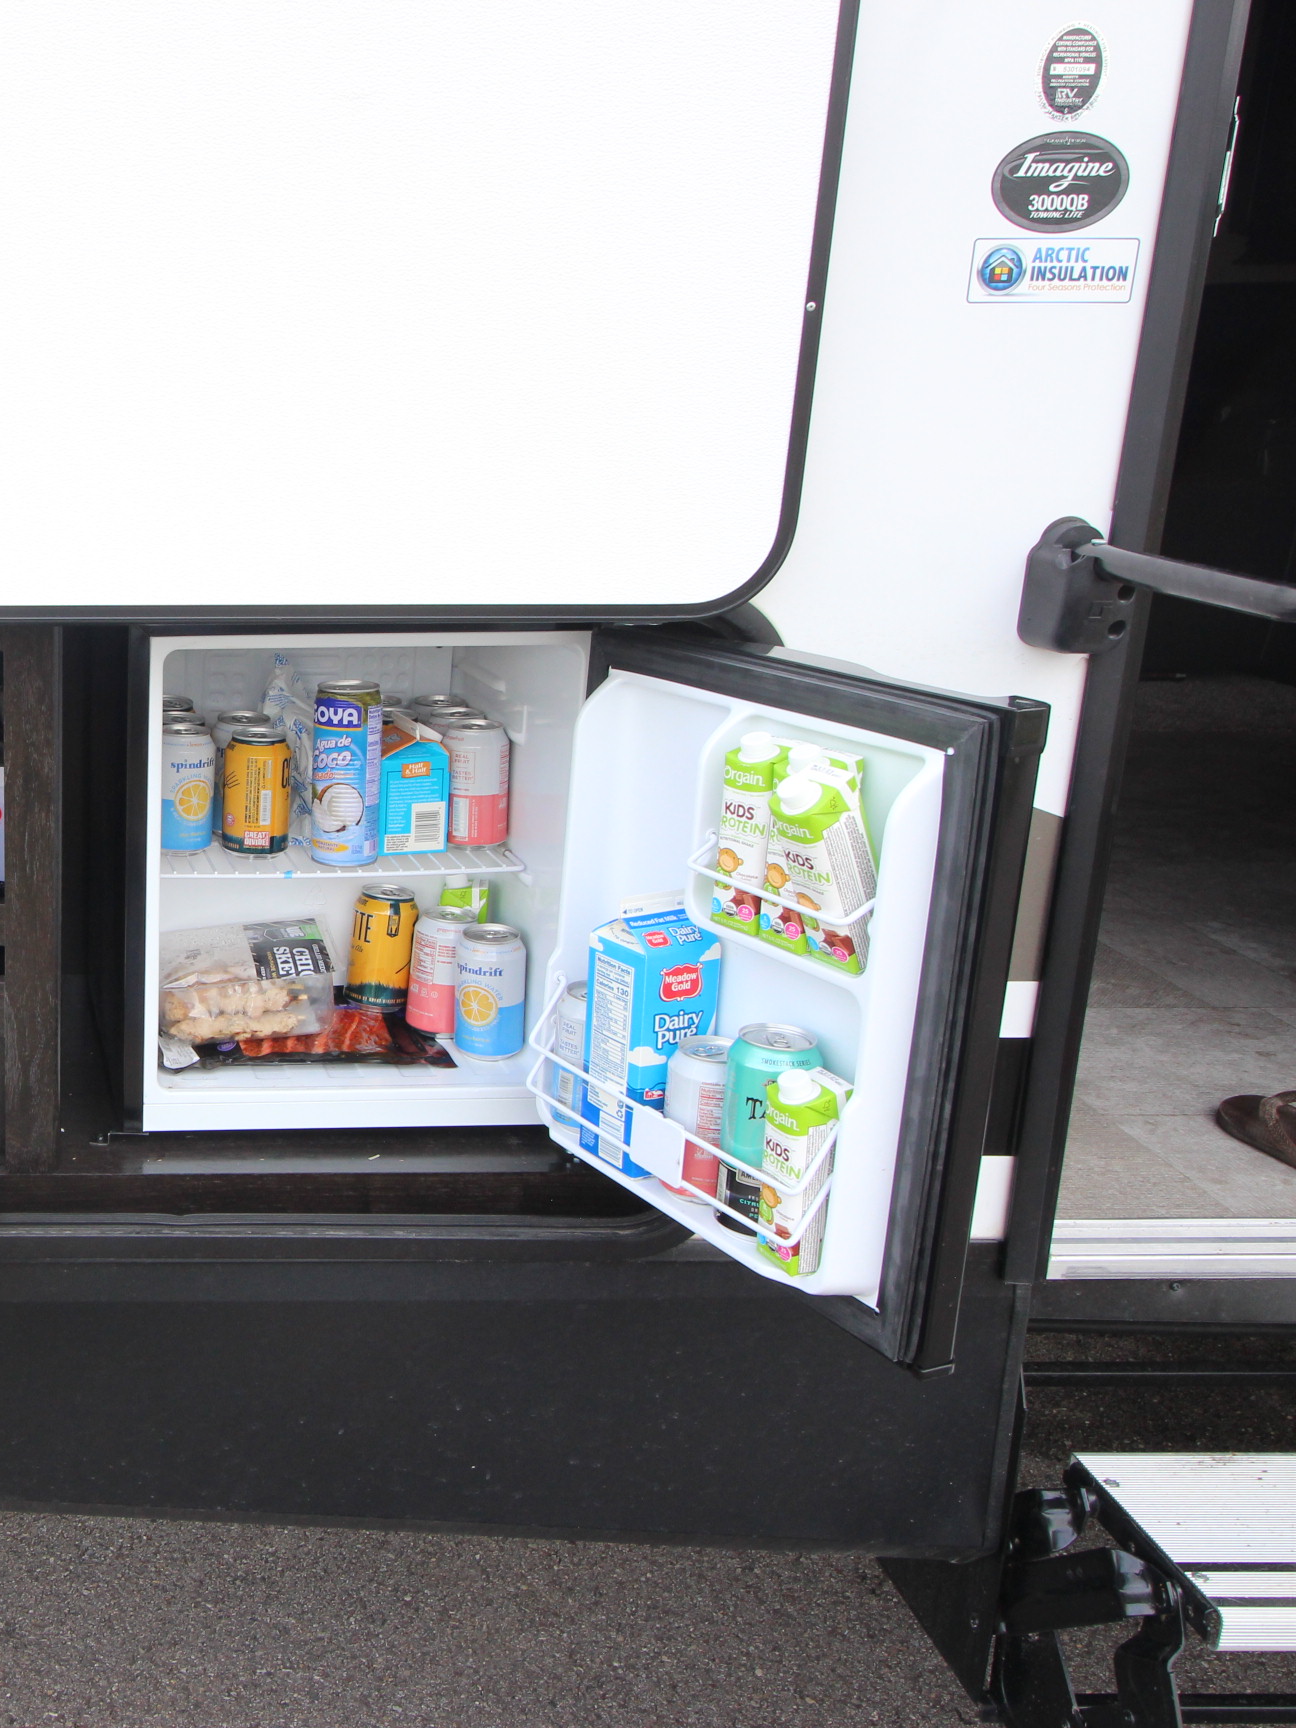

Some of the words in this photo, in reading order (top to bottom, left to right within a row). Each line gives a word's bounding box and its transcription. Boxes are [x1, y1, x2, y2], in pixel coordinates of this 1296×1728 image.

[1056, 88, 1078, 98] RV
[1013, 151, 1116, 192] Imagine
[1028, 194, 1089, 212] 3000QB
[1032, 247, 1090, 263] ARCTIC
[1030, 265, 1129, 282] INSULATION
[316, 739, 335, 751] Agua
[337, 734, 352, 747] de
[170, 758, 214, 773] spindrift
[721, 815, 766, 837] ROTEIN
[245, 831, 266, 839] GREAT
[787, 863, 831, 884] ROTEIN
[630, 918, 654, 927] Reduced
[669, 924, 700, 937] Dairy
[677, 932, 702, 946] Pure
[273, 946, 296, 979] SKE
[597, 956, 616, 969] Nutrition
[618, 965, 631, 975] Facts
[665, 972, 697, 985] Meadow
[671, 981, 691, 992] Gold
[596, 978, 614, 991] Calories
[616, 986, 629, 997] 130
[654, 1010, 704, 1032] Dairy
[656, 1026, 697, 1050] Pure
[761, 1057, 795, 1067] SMOKESTACK
[763, 1149, 802, 1180] ROTEIN
